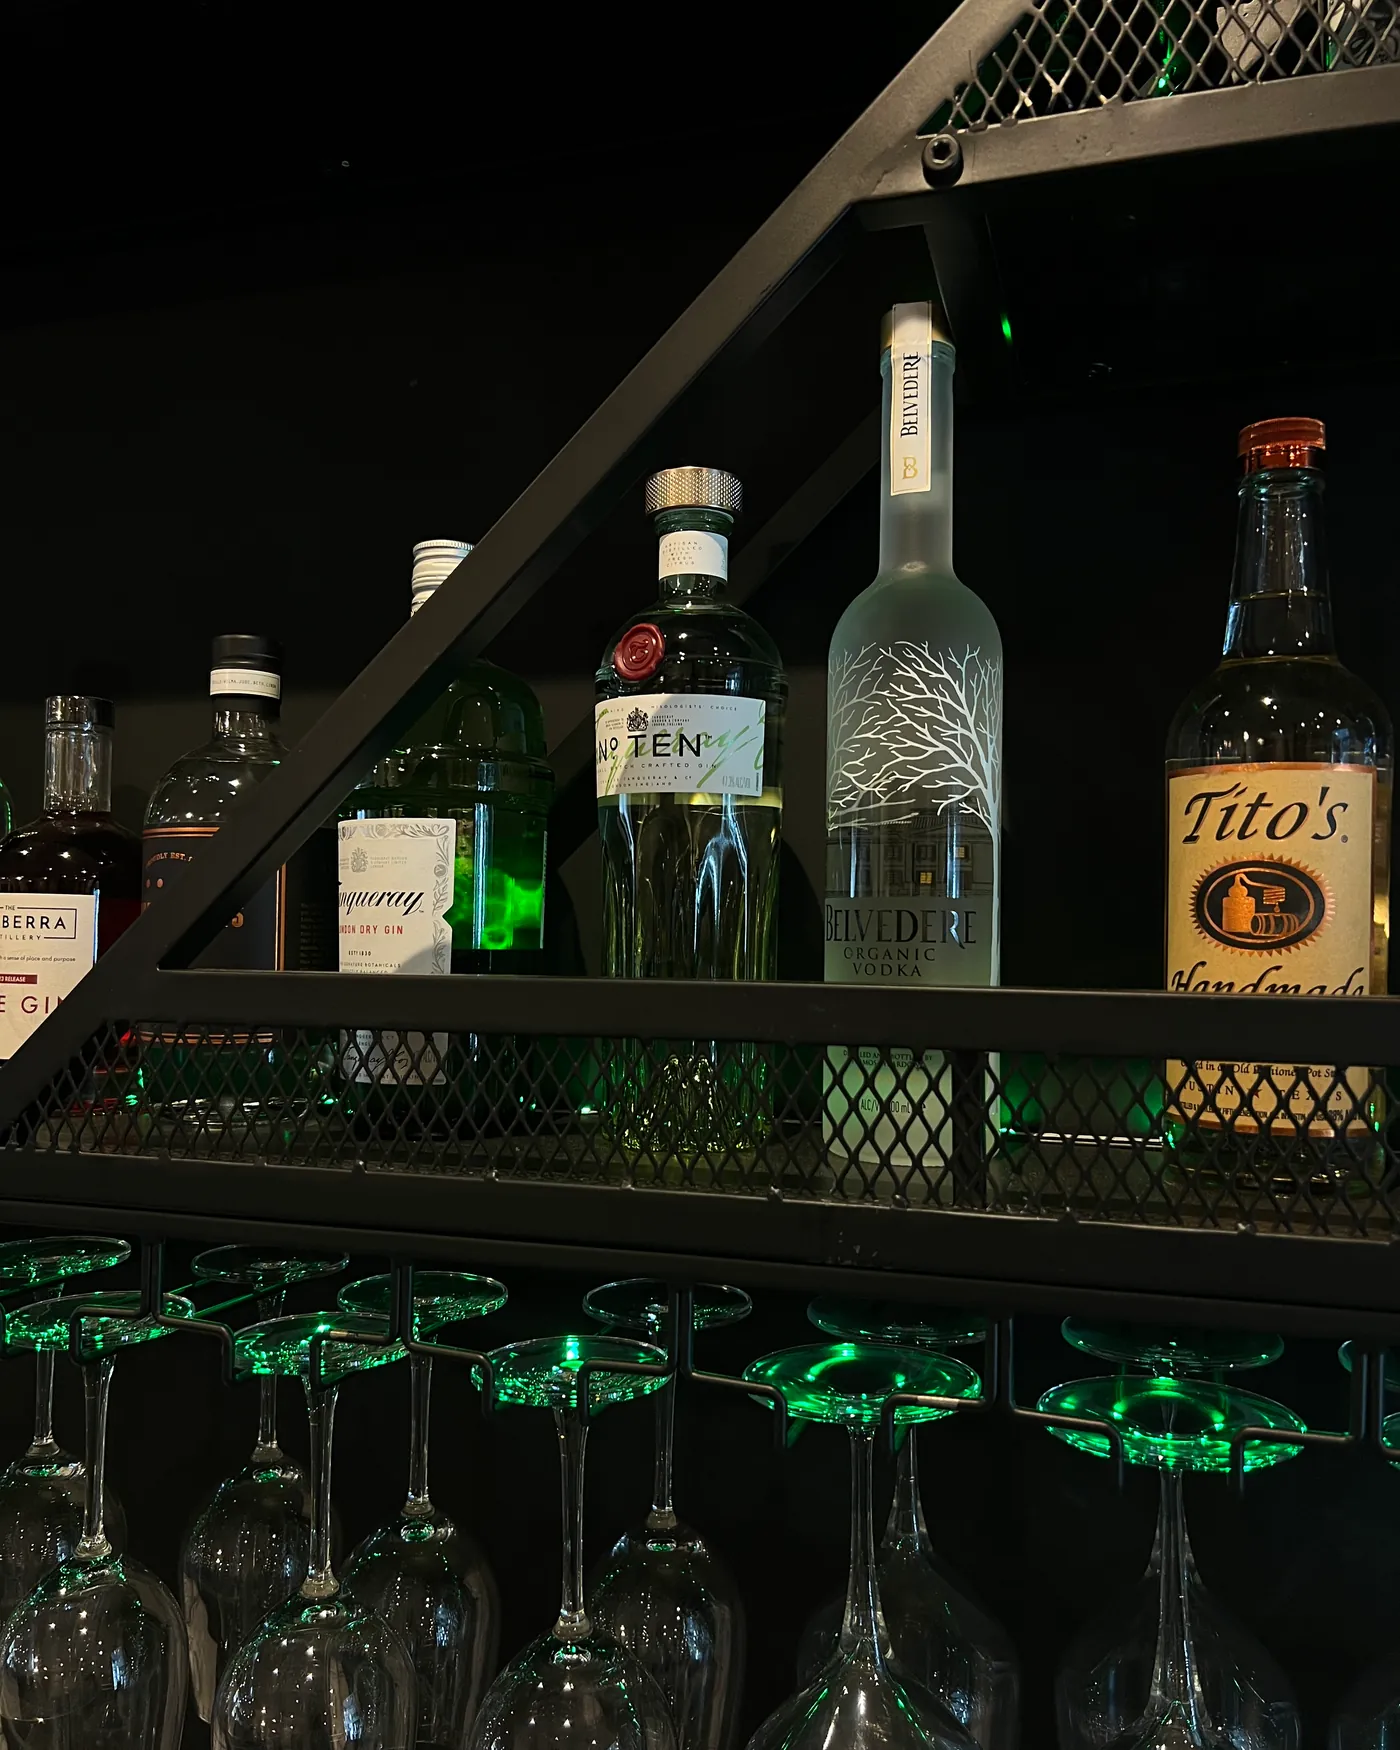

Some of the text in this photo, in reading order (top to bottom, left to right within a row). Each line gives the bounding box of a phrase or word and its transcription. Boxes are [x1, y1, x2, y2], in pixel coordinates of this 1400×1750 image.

[900, 351, 921, 438] BELVEDERE
[1182, 782, 1348, 844] Tito's
[338, 890, 424, 916] nqueray
[360, 925, 378, 934] DRY
[384, 925, 404, 935] GIN
[826, 904, 977, 949] BELVEDERE
[844, 947, 935, 961] ORGANIC
[853, 963, 921, 976] VODKA
[1206, 1061, 1215, 1071] in
[1233, 1063, 1249, 1074] Old
